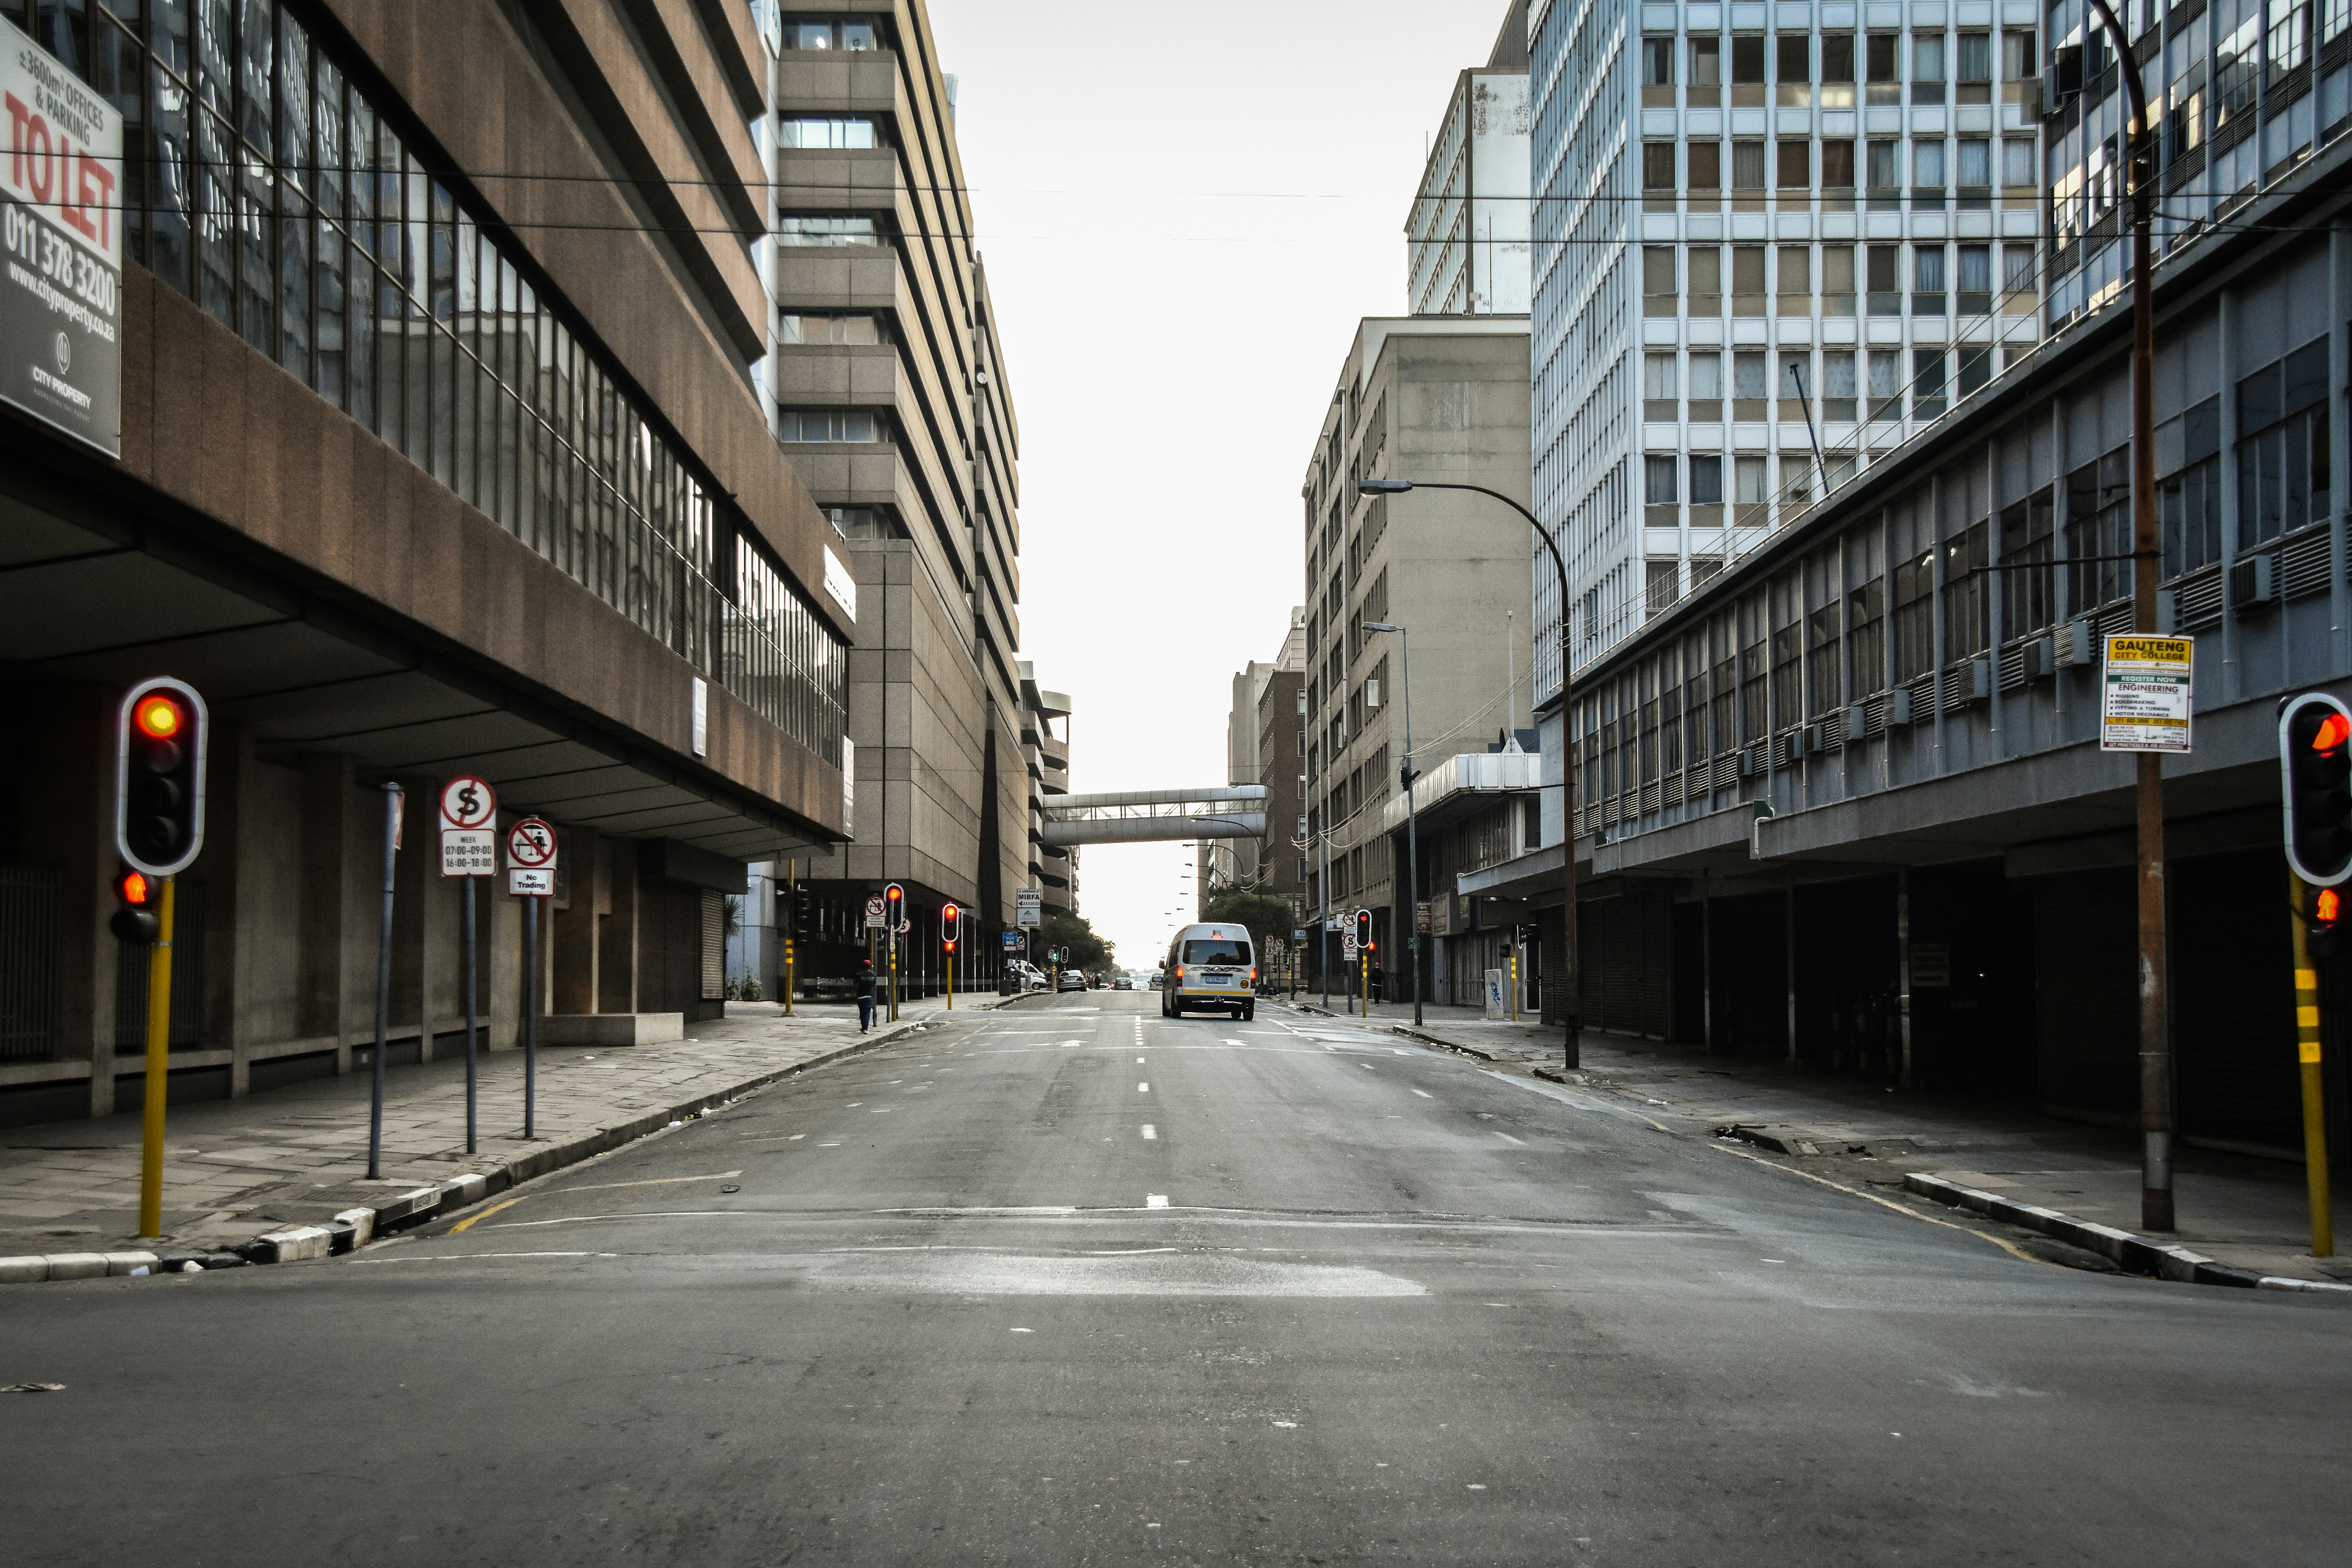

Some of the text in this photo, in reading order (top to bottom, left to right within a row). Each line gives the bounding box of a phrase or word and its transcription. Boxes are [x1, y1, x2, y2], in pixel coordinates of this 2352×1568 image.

[36, 85, 90, 147] & PARKING
[66, 83, 103, 132] OFFICES
[6, 91, 115, 251] TO LET
[6, 203, 115, 316] 011 378 3200
[11, 261, 114, 343] www.cityproperty.co.za
[34, 367, 92, 410] CITY PROPERTY
[2115, 641, 2184, 652] GAUTENG
[2141, 652, 2184, 660] COLLEGE
[2118, 684, 2178, 693] ENGINEERING
[446, 846, 492, 855] 07:00-09:00
[446, 858, 492, 867] 16:00-18:00
